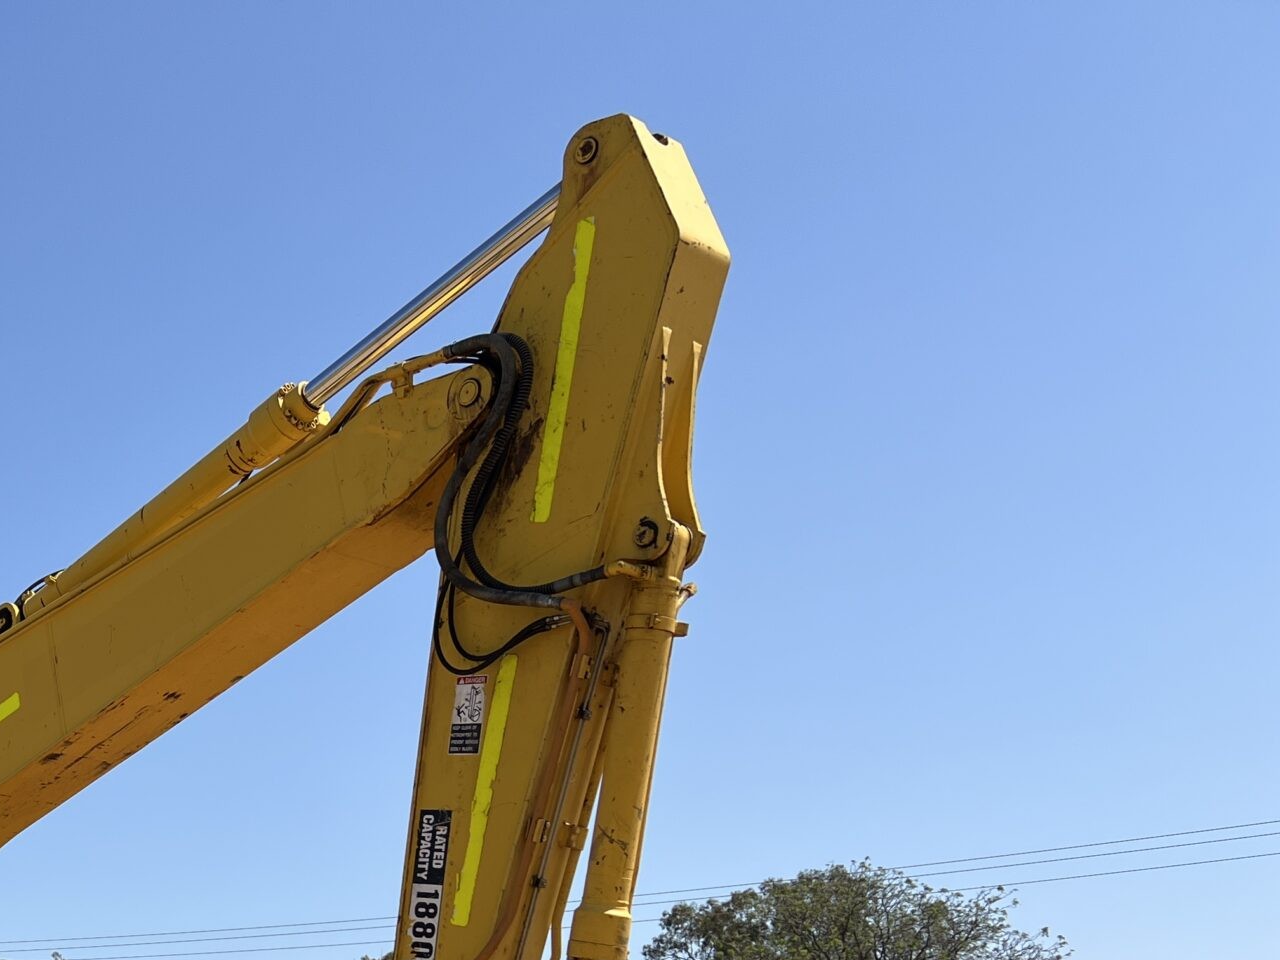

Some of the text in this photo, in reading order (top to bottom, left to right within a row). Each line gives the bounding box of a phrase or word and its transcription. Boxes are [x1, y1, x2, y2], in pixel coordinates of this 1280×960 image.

[465, 676, 486, 684] DANGER
[417, 814, 435, 881] CAPACITY
[432, 825, 448, 869] RATED
